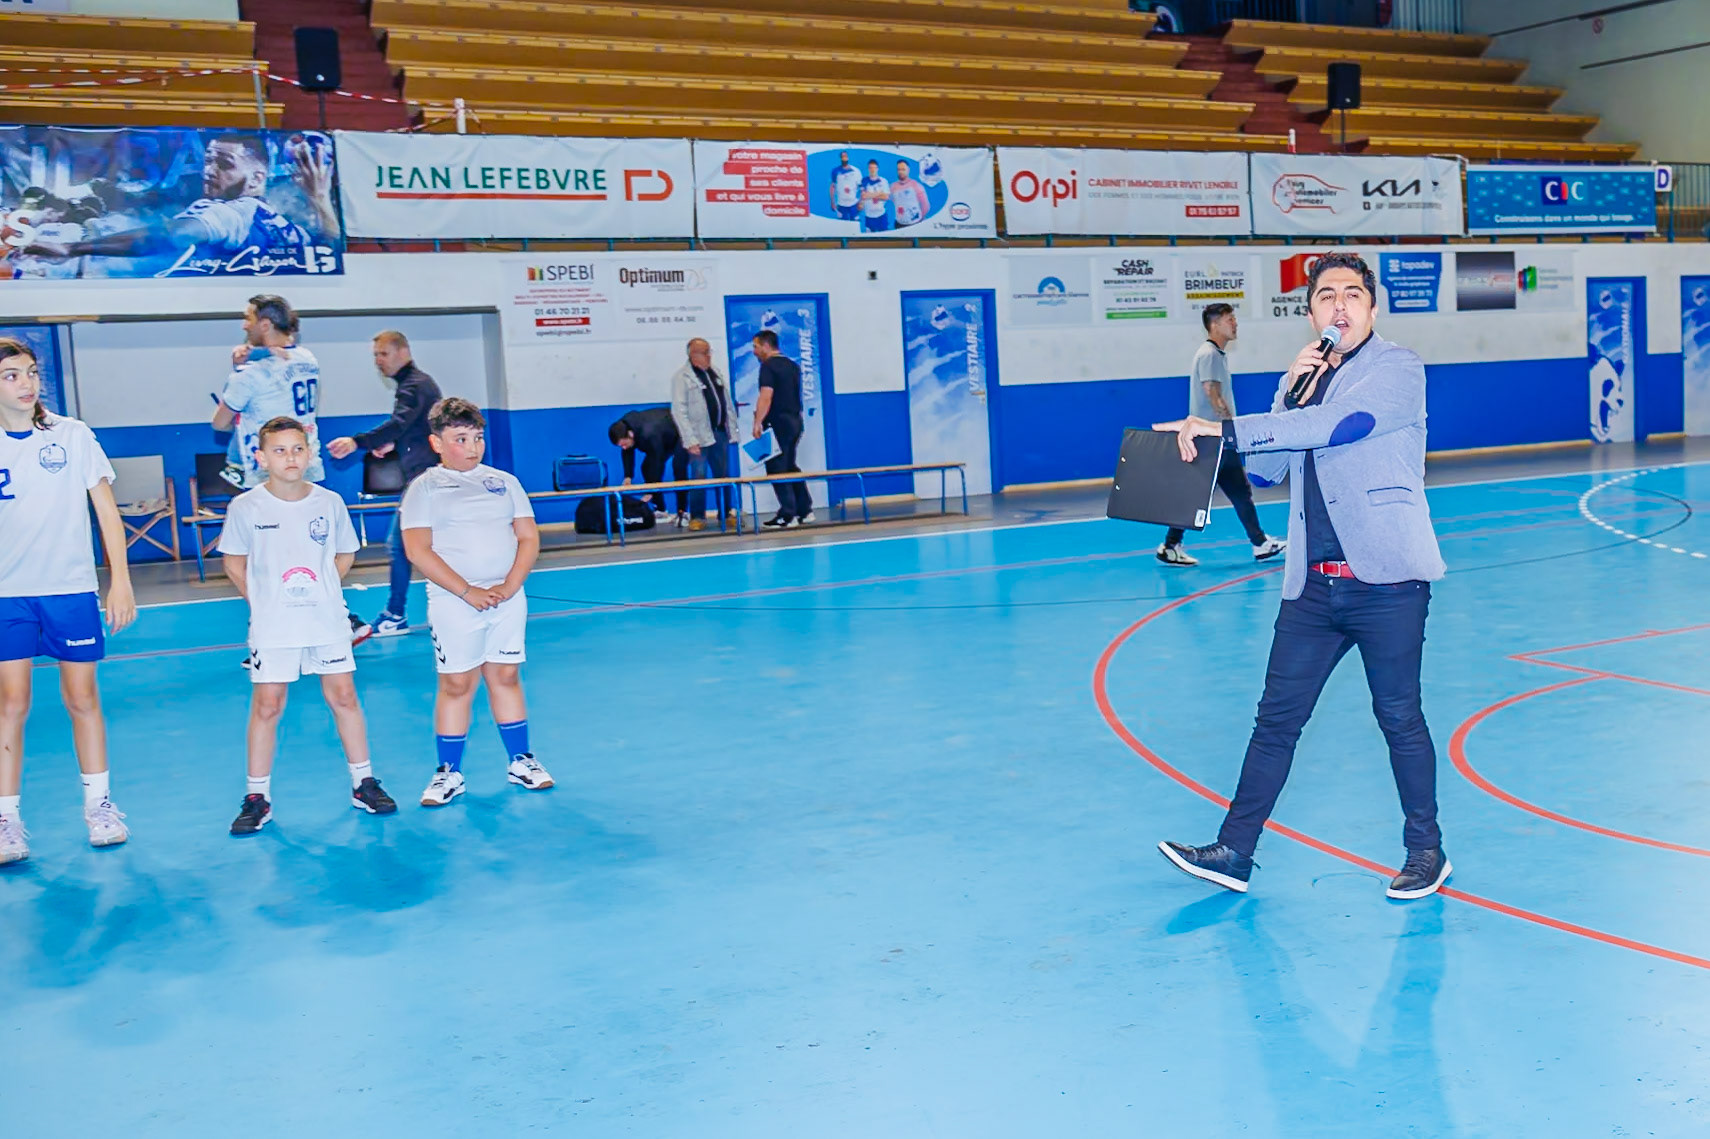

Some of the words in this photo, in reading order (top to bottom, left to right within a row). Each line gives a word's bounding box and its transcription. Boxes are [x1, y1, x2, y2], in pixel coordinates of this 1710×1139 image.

[751, 166, 788, 174] proche
[375, 166, 451, 189] JEAN
[463, 167, 607, 190] LEFEBVRE
[1657, 168, 1670, 189] D
[1010, 170, 1078, 207] Orpi
[1087, 178, 1126, 188] CABINET
[1127, 179, 1178, 190] IMMOBILIER
[716, 192, 728, 201] et
[730, 193, 745, 202] qui
[747, 193, 773, 201] vous
[1121, 260, 1150, 268] CASH
[1113, 267, 1155, 276] REPAIR
[619, 267, 685, 288] Optimum
[1184, 279, 1245, 290] BRIMBEUF
[797, 308, 810, 318] 3
[964, 303, 977, 313] 2
[1273, 306, 1288, 317] 01
[966, 322, 981, 392] VESTIAIRE
[798, 328, 815, 401] VESTIAIRE
